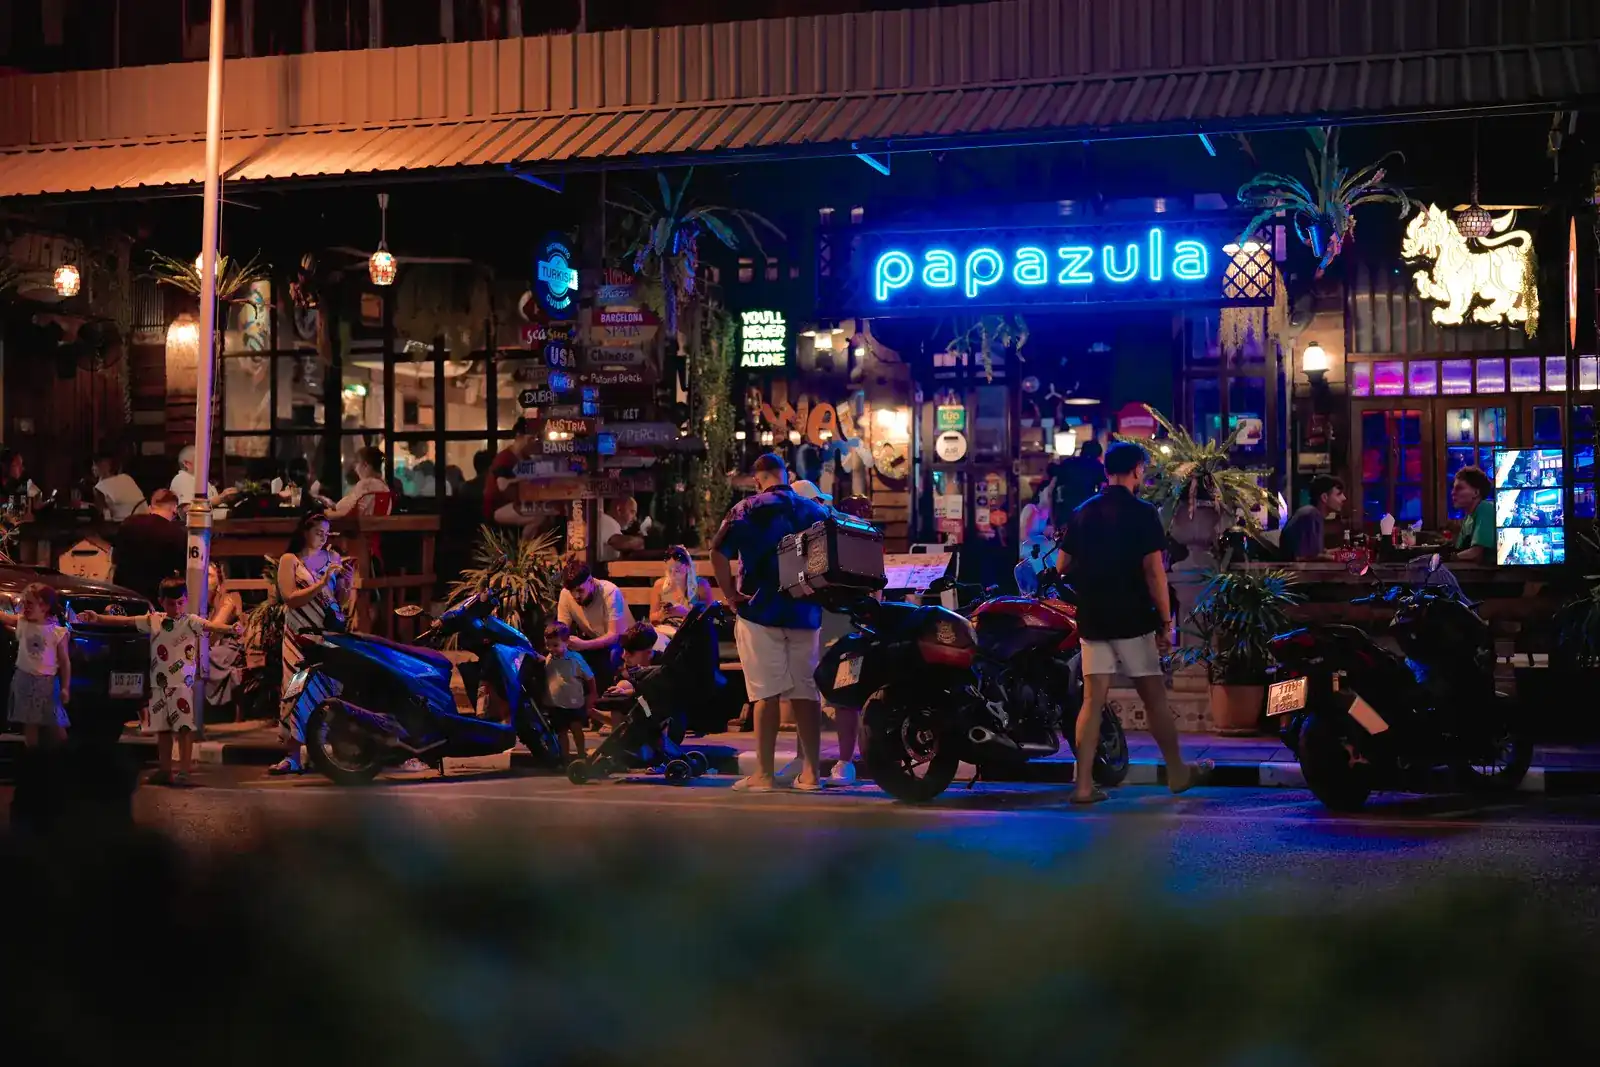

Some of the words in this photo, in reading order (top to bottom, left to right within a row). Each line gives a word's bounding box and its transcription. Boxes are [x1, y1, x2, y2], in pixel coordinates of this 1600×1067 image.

[875, 228, 1209, 301] papazula
[542, 265, 576, 286] TURKISH
[546, 294, 571, 310] CUISINE
[601, 313, 643, 323] BARCELONA
[742, 324, 786, 339] NEVER
[742, 338, 786, 353] DRINK
[550, 346, 576, 368] USA
[740, 352, 786, 367] ALONE
[619, 373, 642, 383] Beach
[545, 419, 587, 432] AUSTRIA
